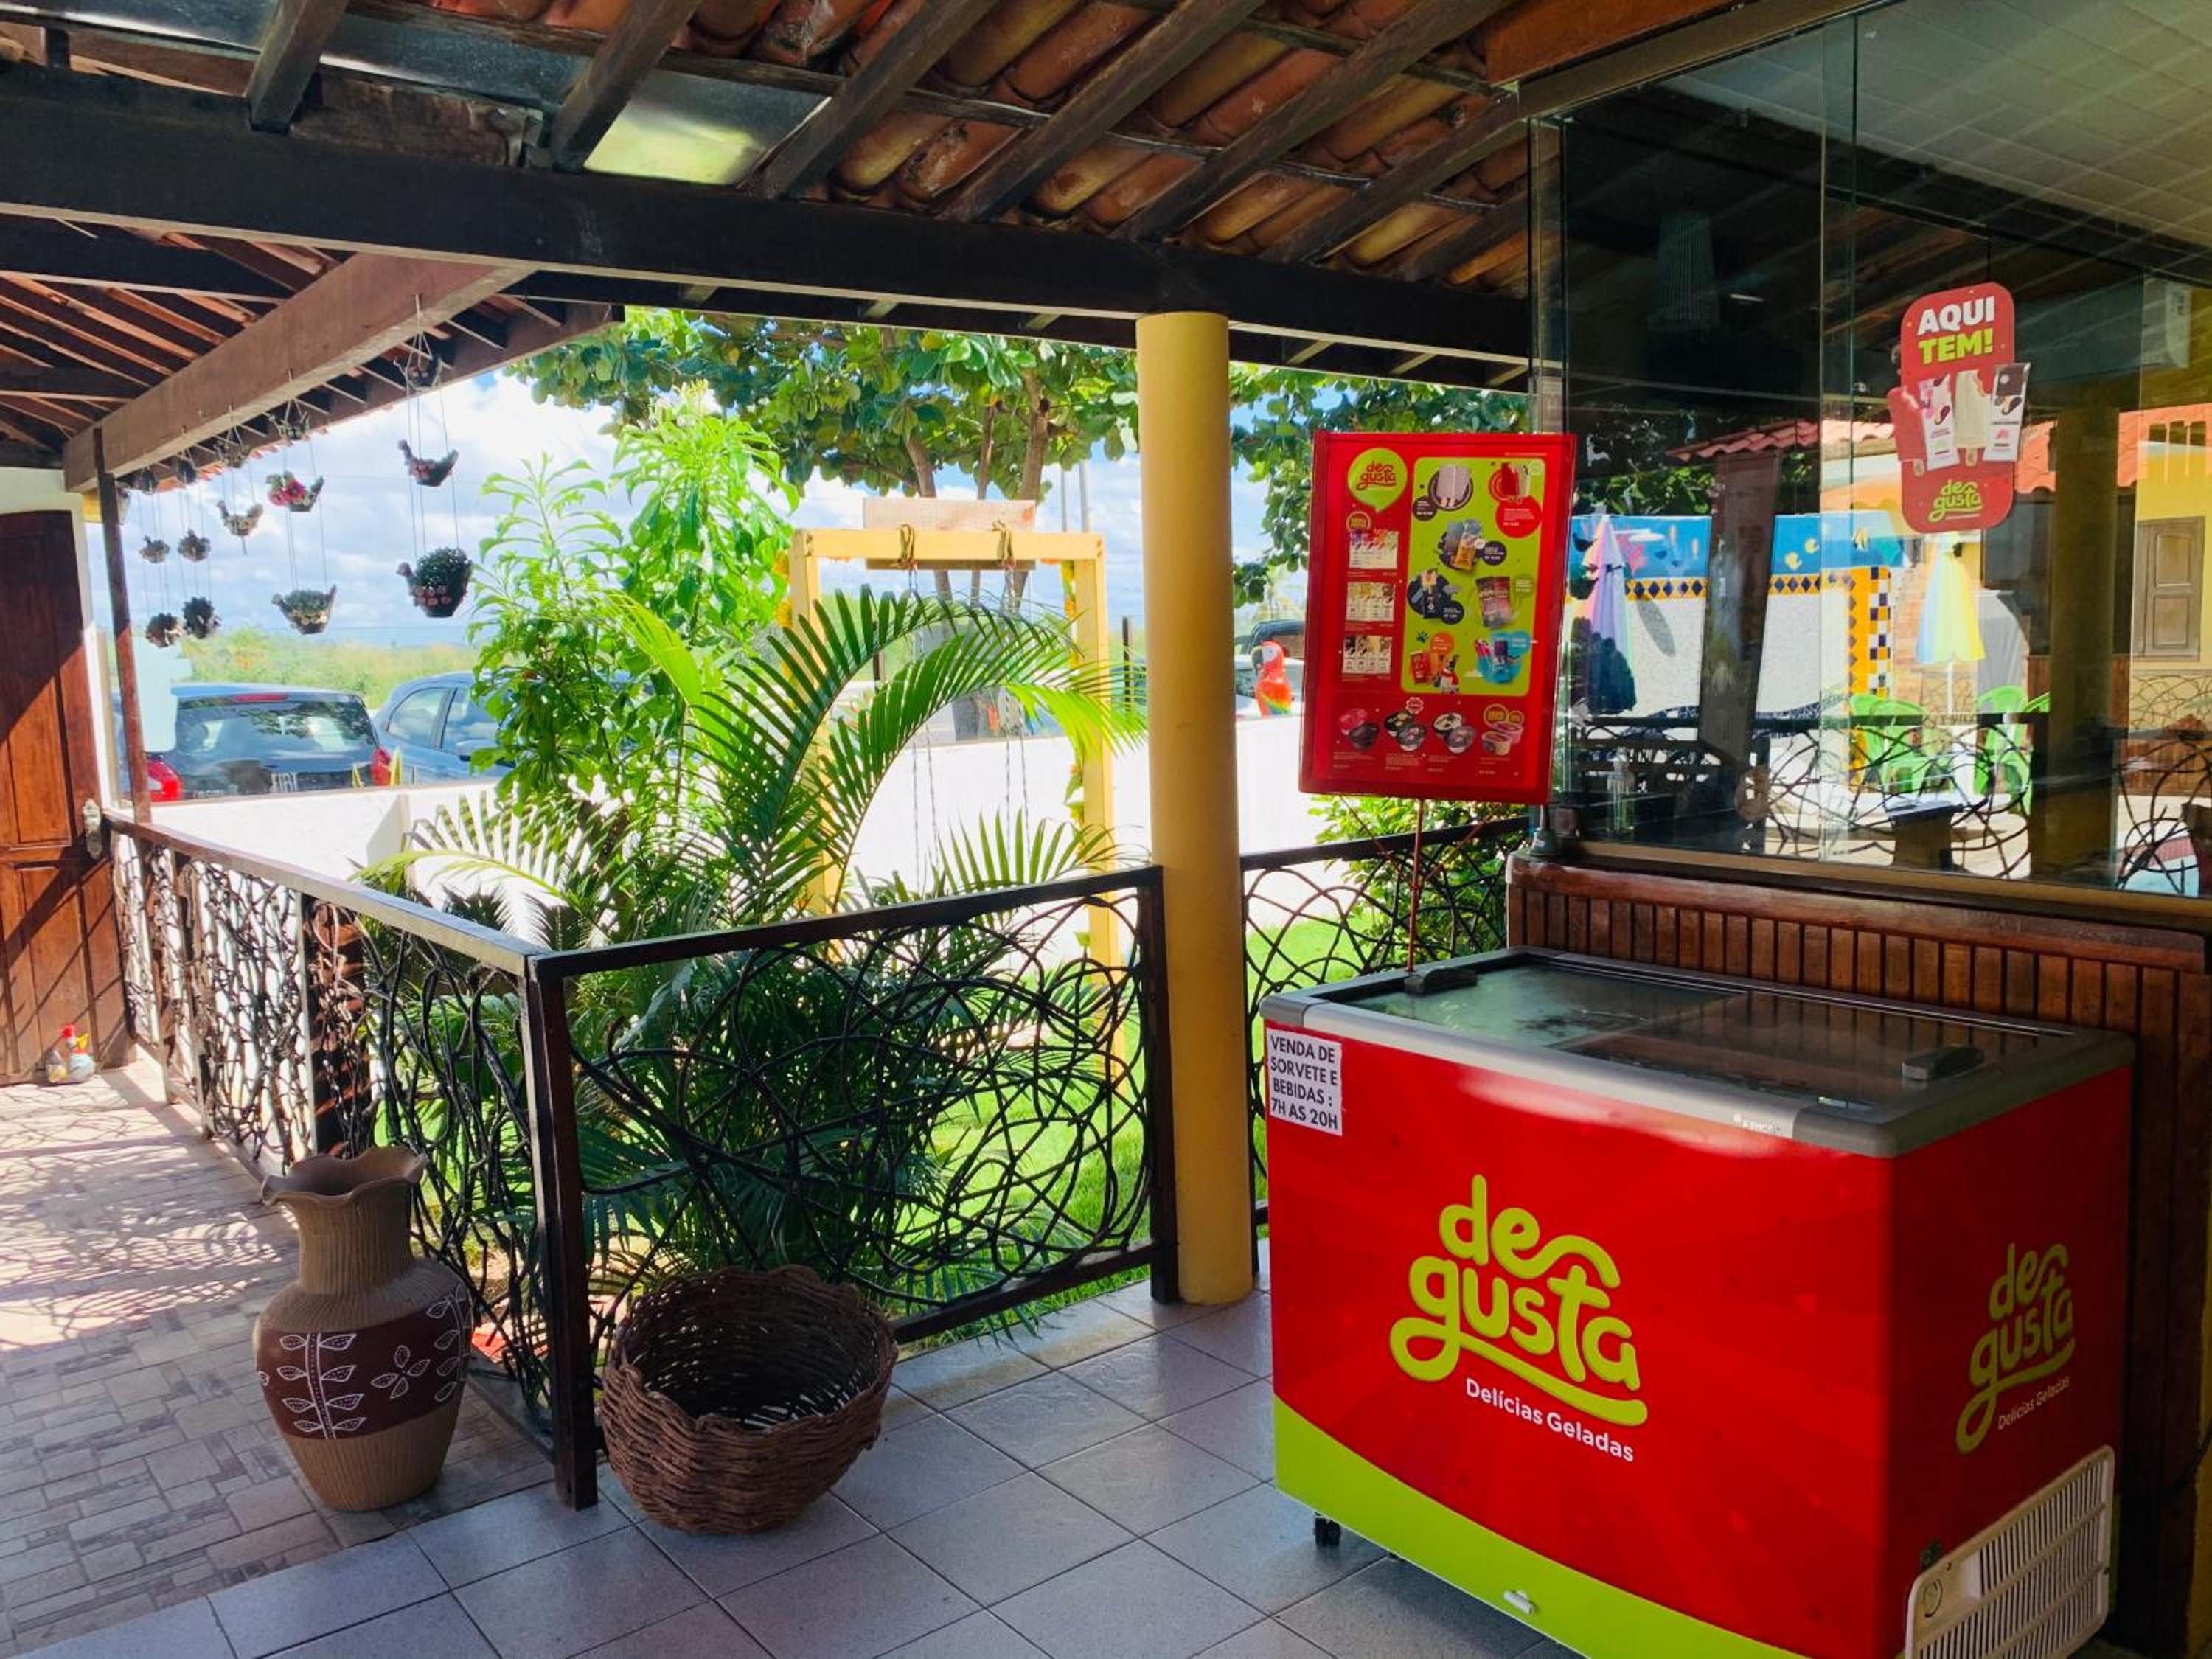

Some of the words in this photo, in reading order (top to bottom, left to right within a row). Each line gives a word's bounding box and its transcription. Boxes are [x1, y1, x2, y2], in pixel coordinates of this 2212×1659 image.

[1917, 296, 1994, 336] AQUI
[1919, 327, 1994, 364] TEM!
[1356, 470, 1397, 491] gusta
[1366, 459, 1394, 473] de
[1928, 487, 1983, 523] gusta
[1941, 479, 1978, 496] de
[1270, 1034, 1315, 1059] VENDA
[1318, 1044, 1335, 1063] DE
[1270, 1056, 1326, 1083] SORVETE
[1330, 1070, 1338, 1086] E
[1271, 1098, 1286, 1116] 7H
[1289, 1103, 1306, 1121] AS
[1310, 1108, 1338, 1130] 20H
[1439, 1175, 1621, 1289] de
[1989, 1242, 2069, 1321] de
[1390, 1255, 1648, 1427] gusta
[1956, 1267, 2076, 1454] gusta
[2036, 1376, 2070, 1407] Geladas
[1467, 1377, 1543, 1425] Delícias
[1546, 1412, 1634, 1462] Geladas
